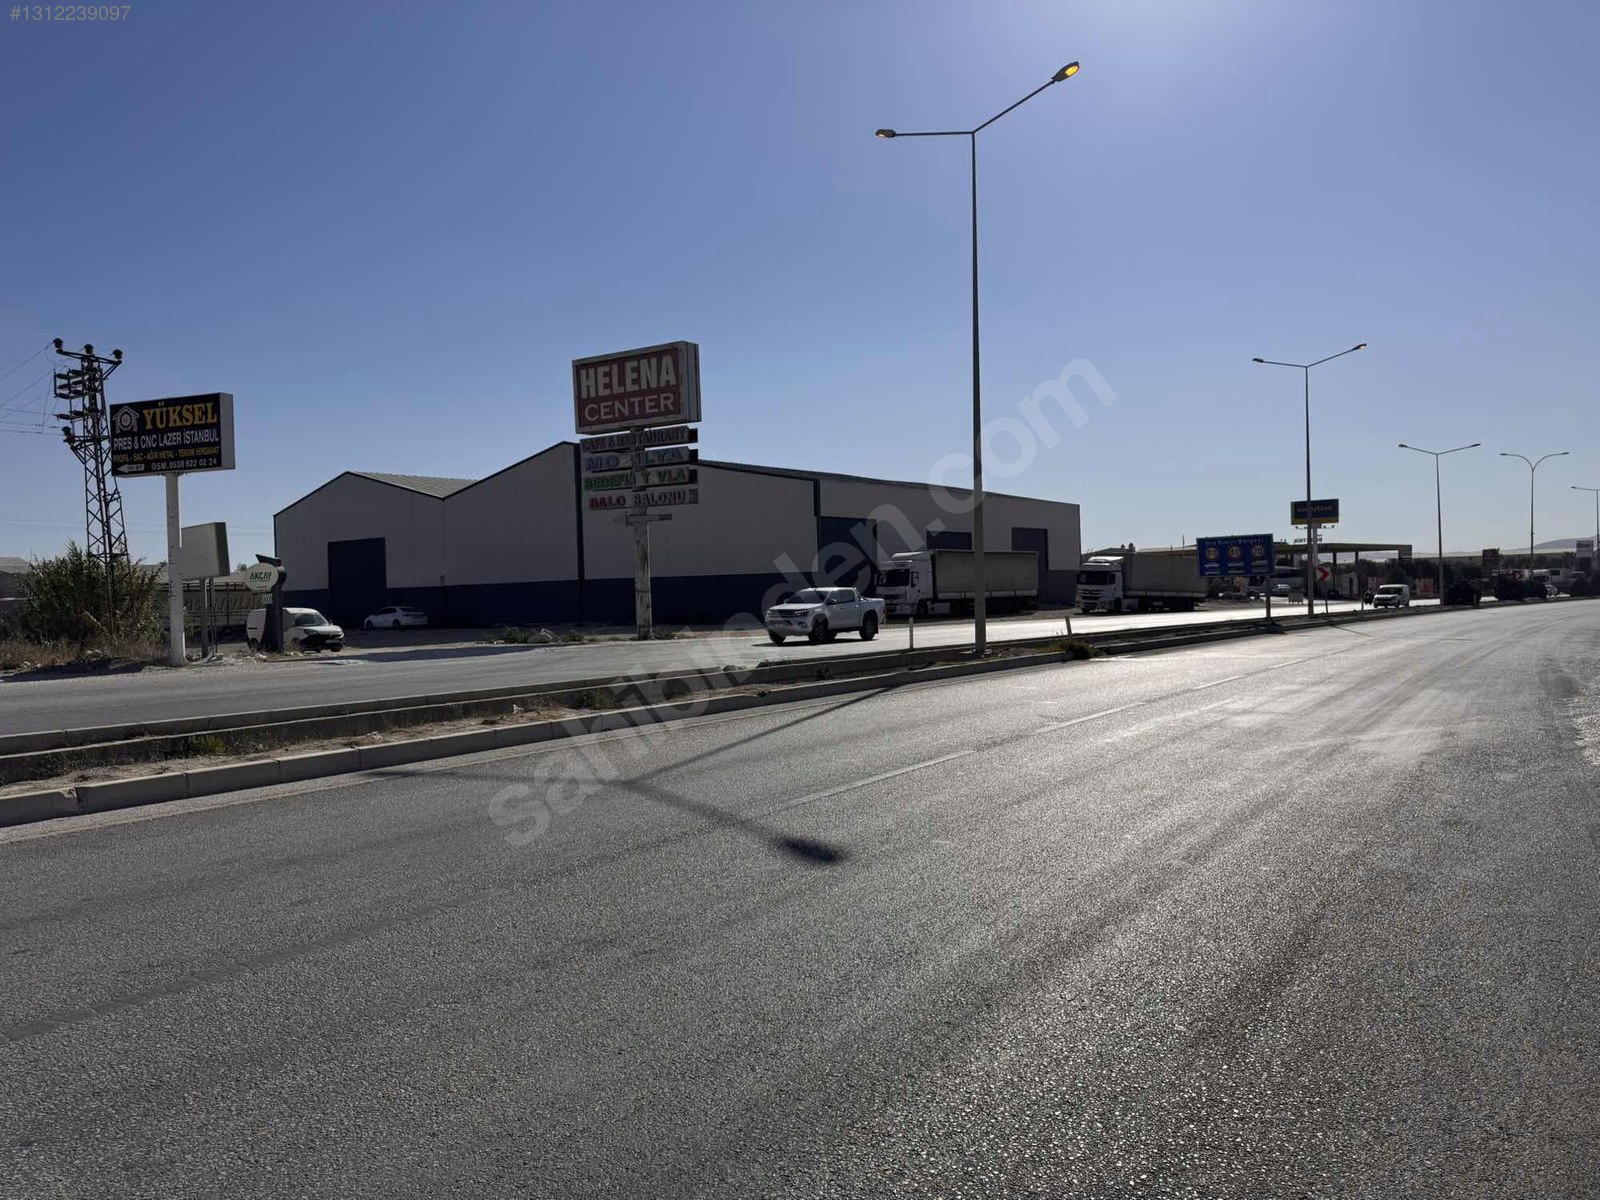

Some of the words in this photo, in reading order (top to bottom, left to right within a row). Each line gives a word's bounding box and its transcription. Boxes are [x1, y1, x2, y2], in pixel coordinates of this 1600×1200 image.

[580, 355, 677, 399] HELENA
[143, 401, 217, 430] YÜKSEL
[584, 393, 675, 421] CENTER
[113, 437, 133, 450] PRES
[134, 437, 139, 448] &
[140, 434, 157, 448] CNC
[159, 432, 182, 447] LAZER
[183, 428, 219, 444] İSTANBUL
[590, 495, 626, 509] BALO
[634, 490, 686, 507] SALONU
